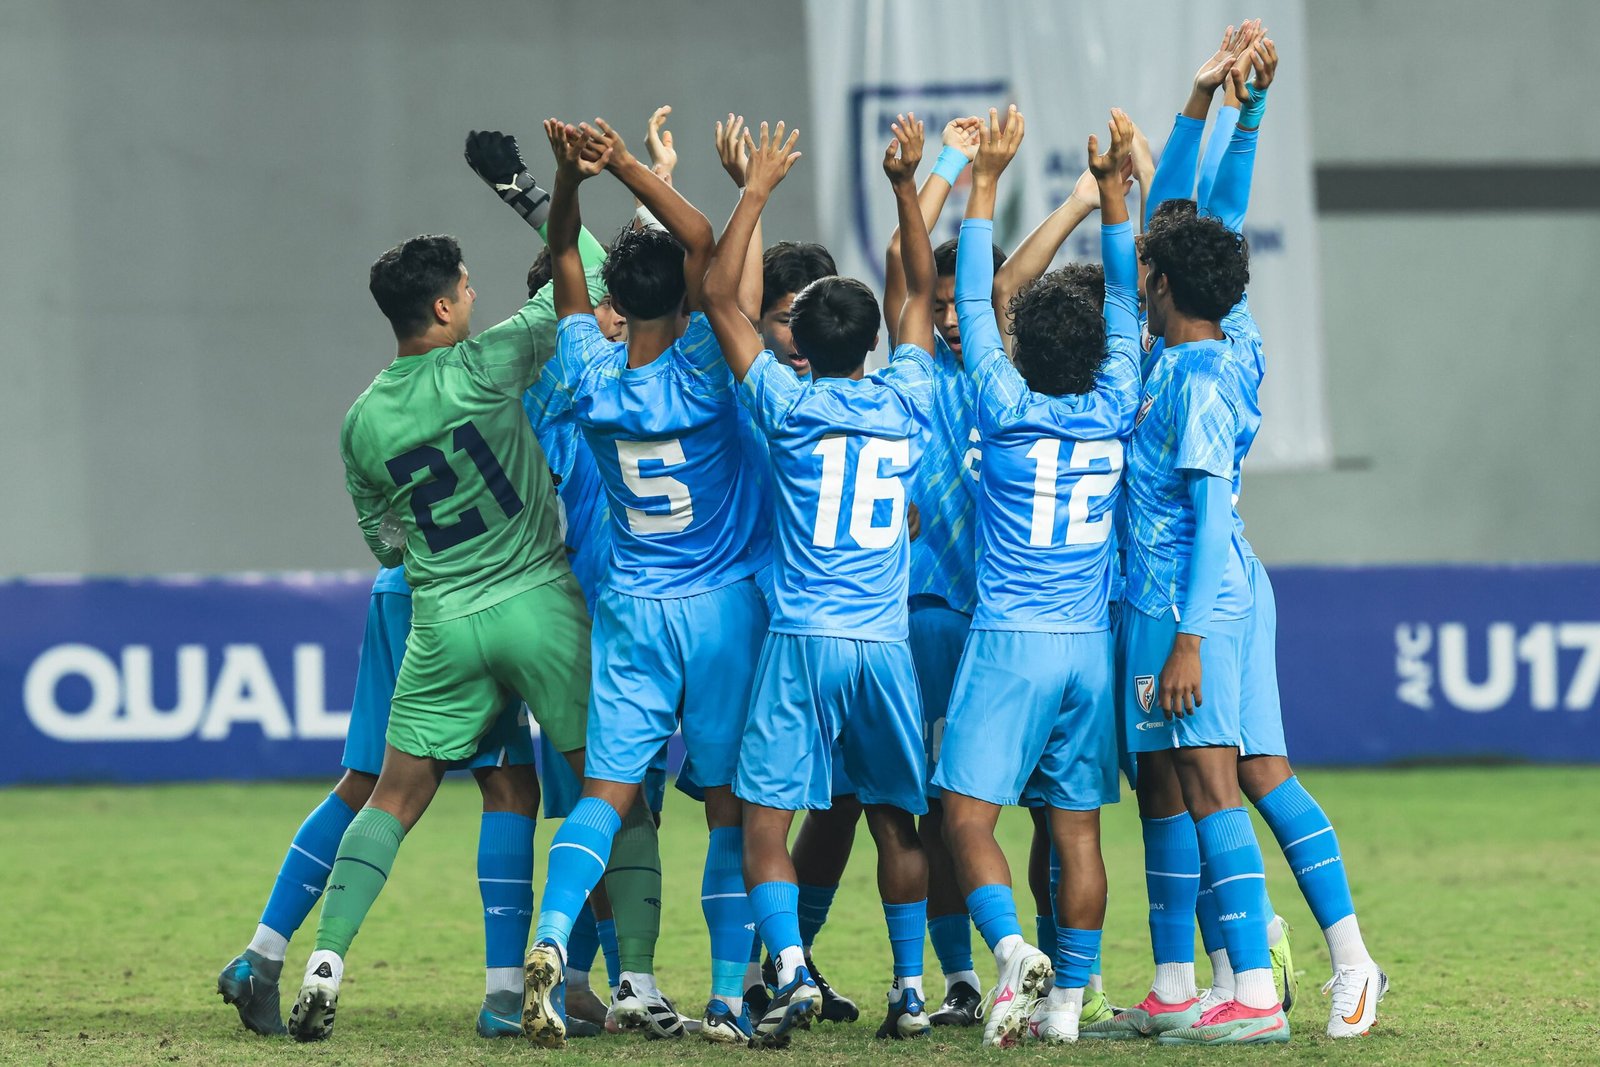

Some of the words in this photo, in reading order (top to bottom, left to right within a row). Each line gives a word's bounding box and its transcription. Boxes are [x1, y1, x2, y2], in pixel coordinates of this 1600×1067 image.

[384, 420, 524, 554] 21
[615, 438, 694, 534] 5
[812, 434, 910, 549] 16
[1025, 438, 1123, 546] 12
[1396, 621, 1433, 710] AFC
[1438, 621, 1600, 712] U17
